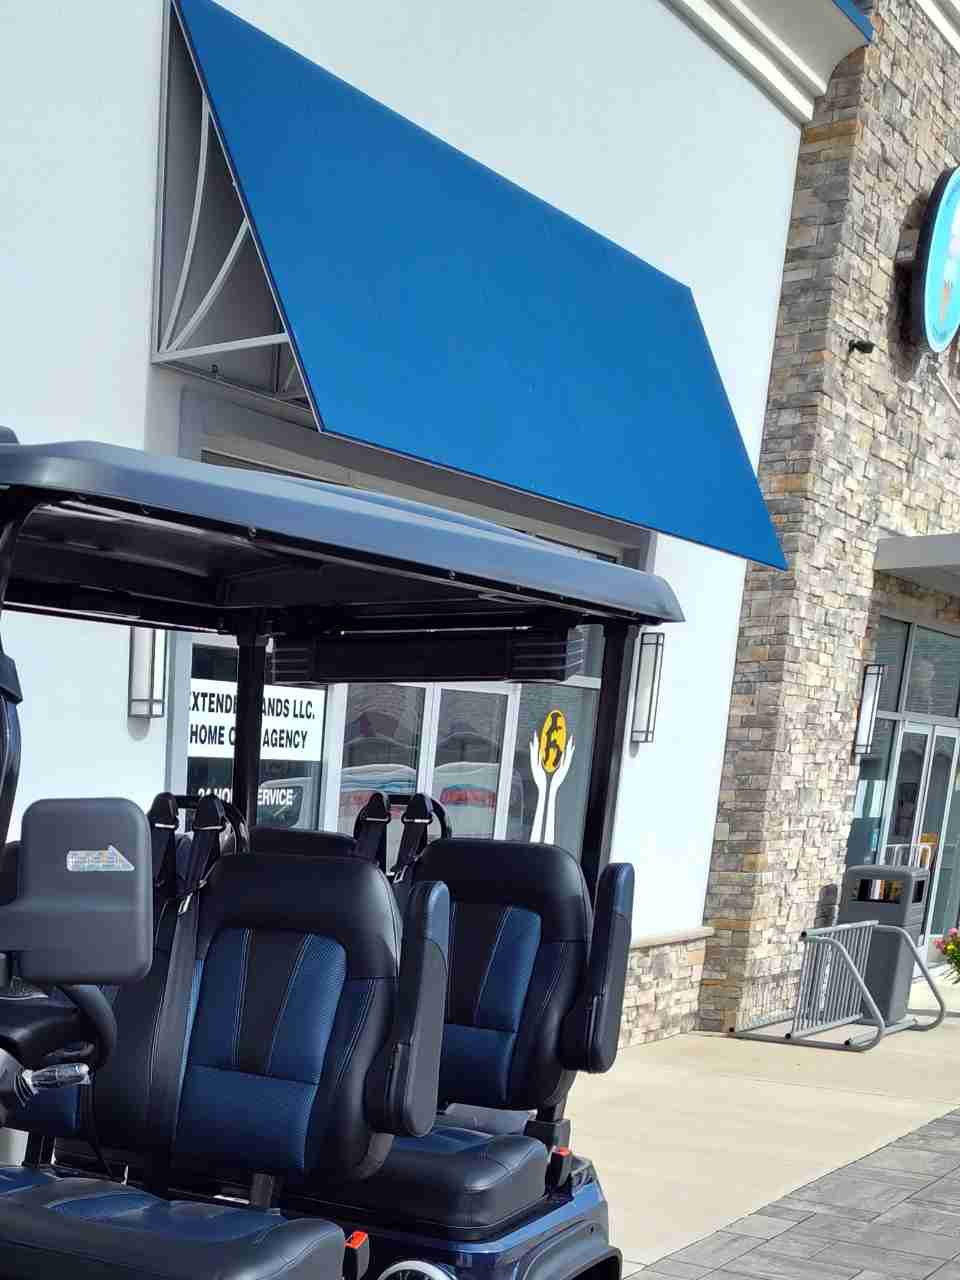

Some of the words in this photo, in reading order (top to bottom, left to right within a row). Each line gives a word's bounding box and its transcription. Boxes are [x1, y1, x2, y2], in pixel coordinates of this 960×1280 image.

[189, 691, 237, 714] XTEND
[261, 697, 289, 718] ANDS
[293, 699, 315, 719] LLC.
[190, 723, 225, 745] HOME
[262, 728, 308, 749] AGENCY
[257, 788, 294, 806] ERVICE
